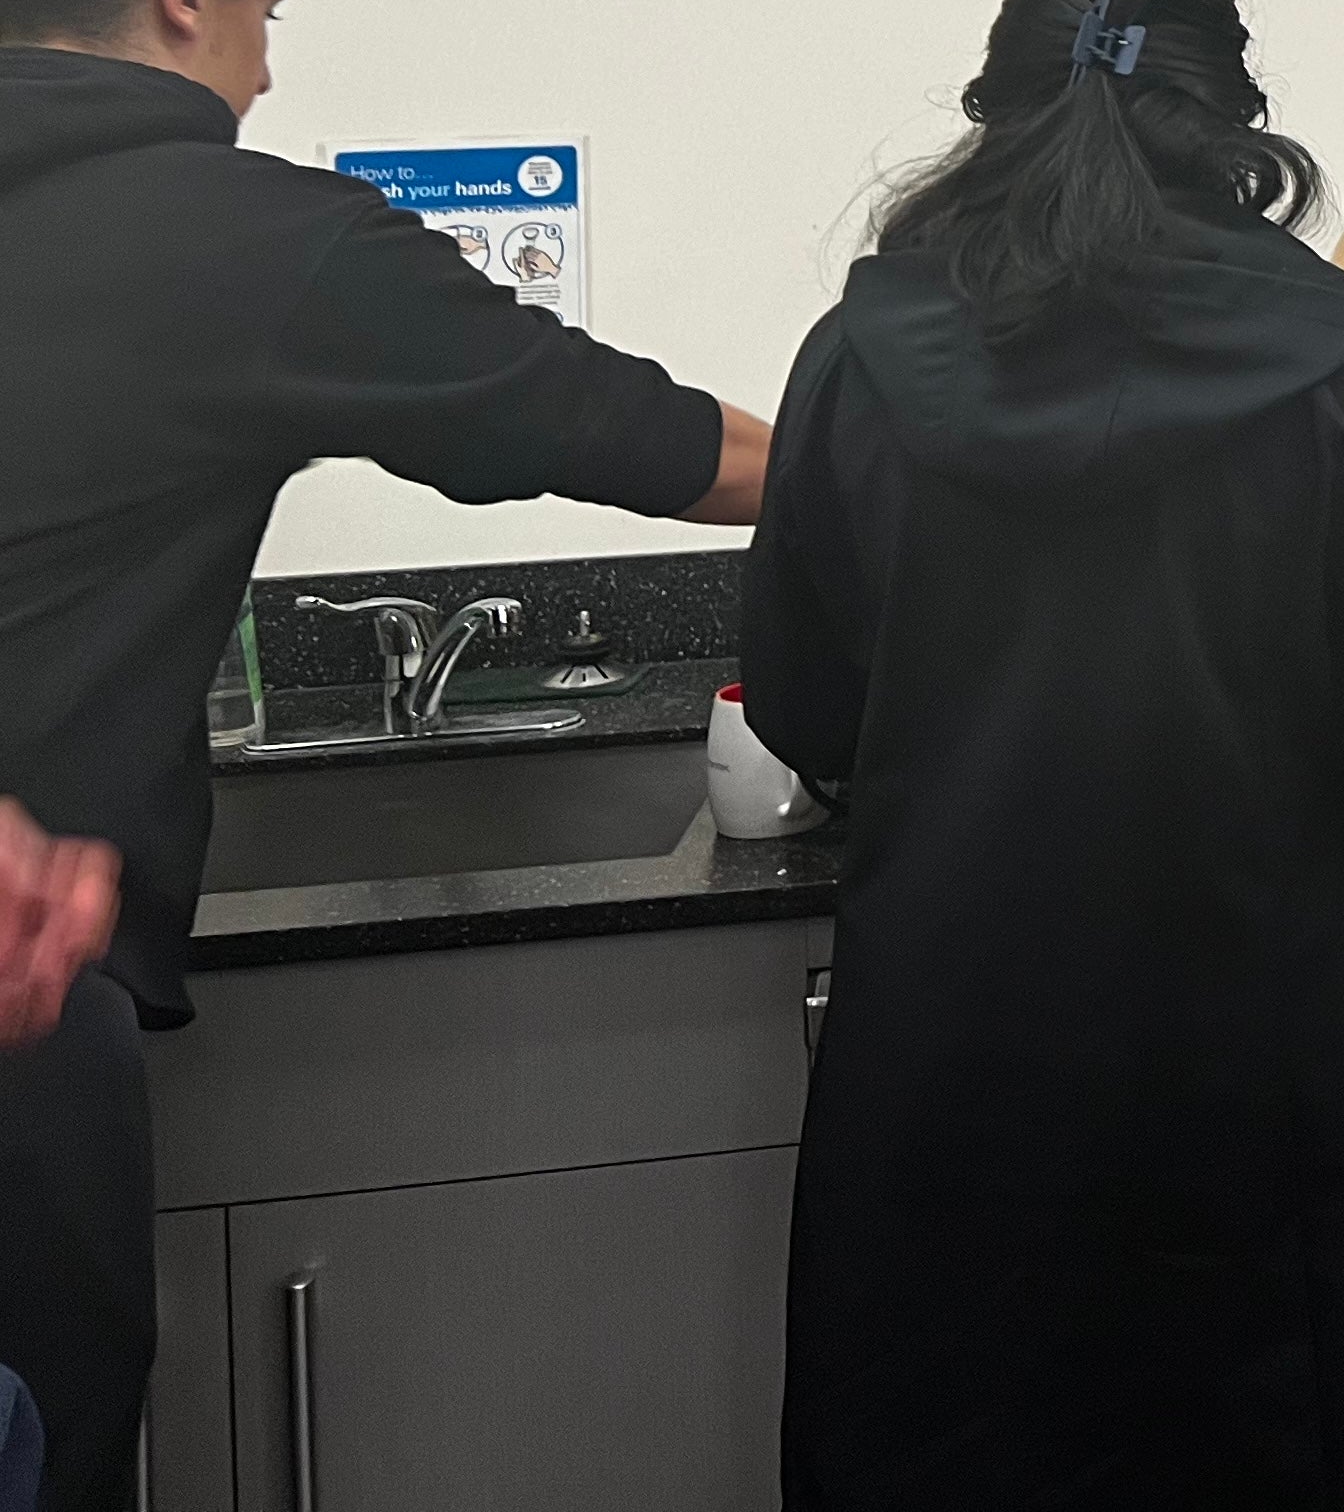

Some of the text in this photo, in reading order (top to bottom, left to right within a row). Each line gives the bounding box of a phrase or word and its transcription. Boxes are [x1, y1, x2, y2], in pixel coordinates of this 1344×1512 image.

[350, 165, 394, 181] How
[408, 185, 451, 201] your
[456, 179, 513, 197] hands
